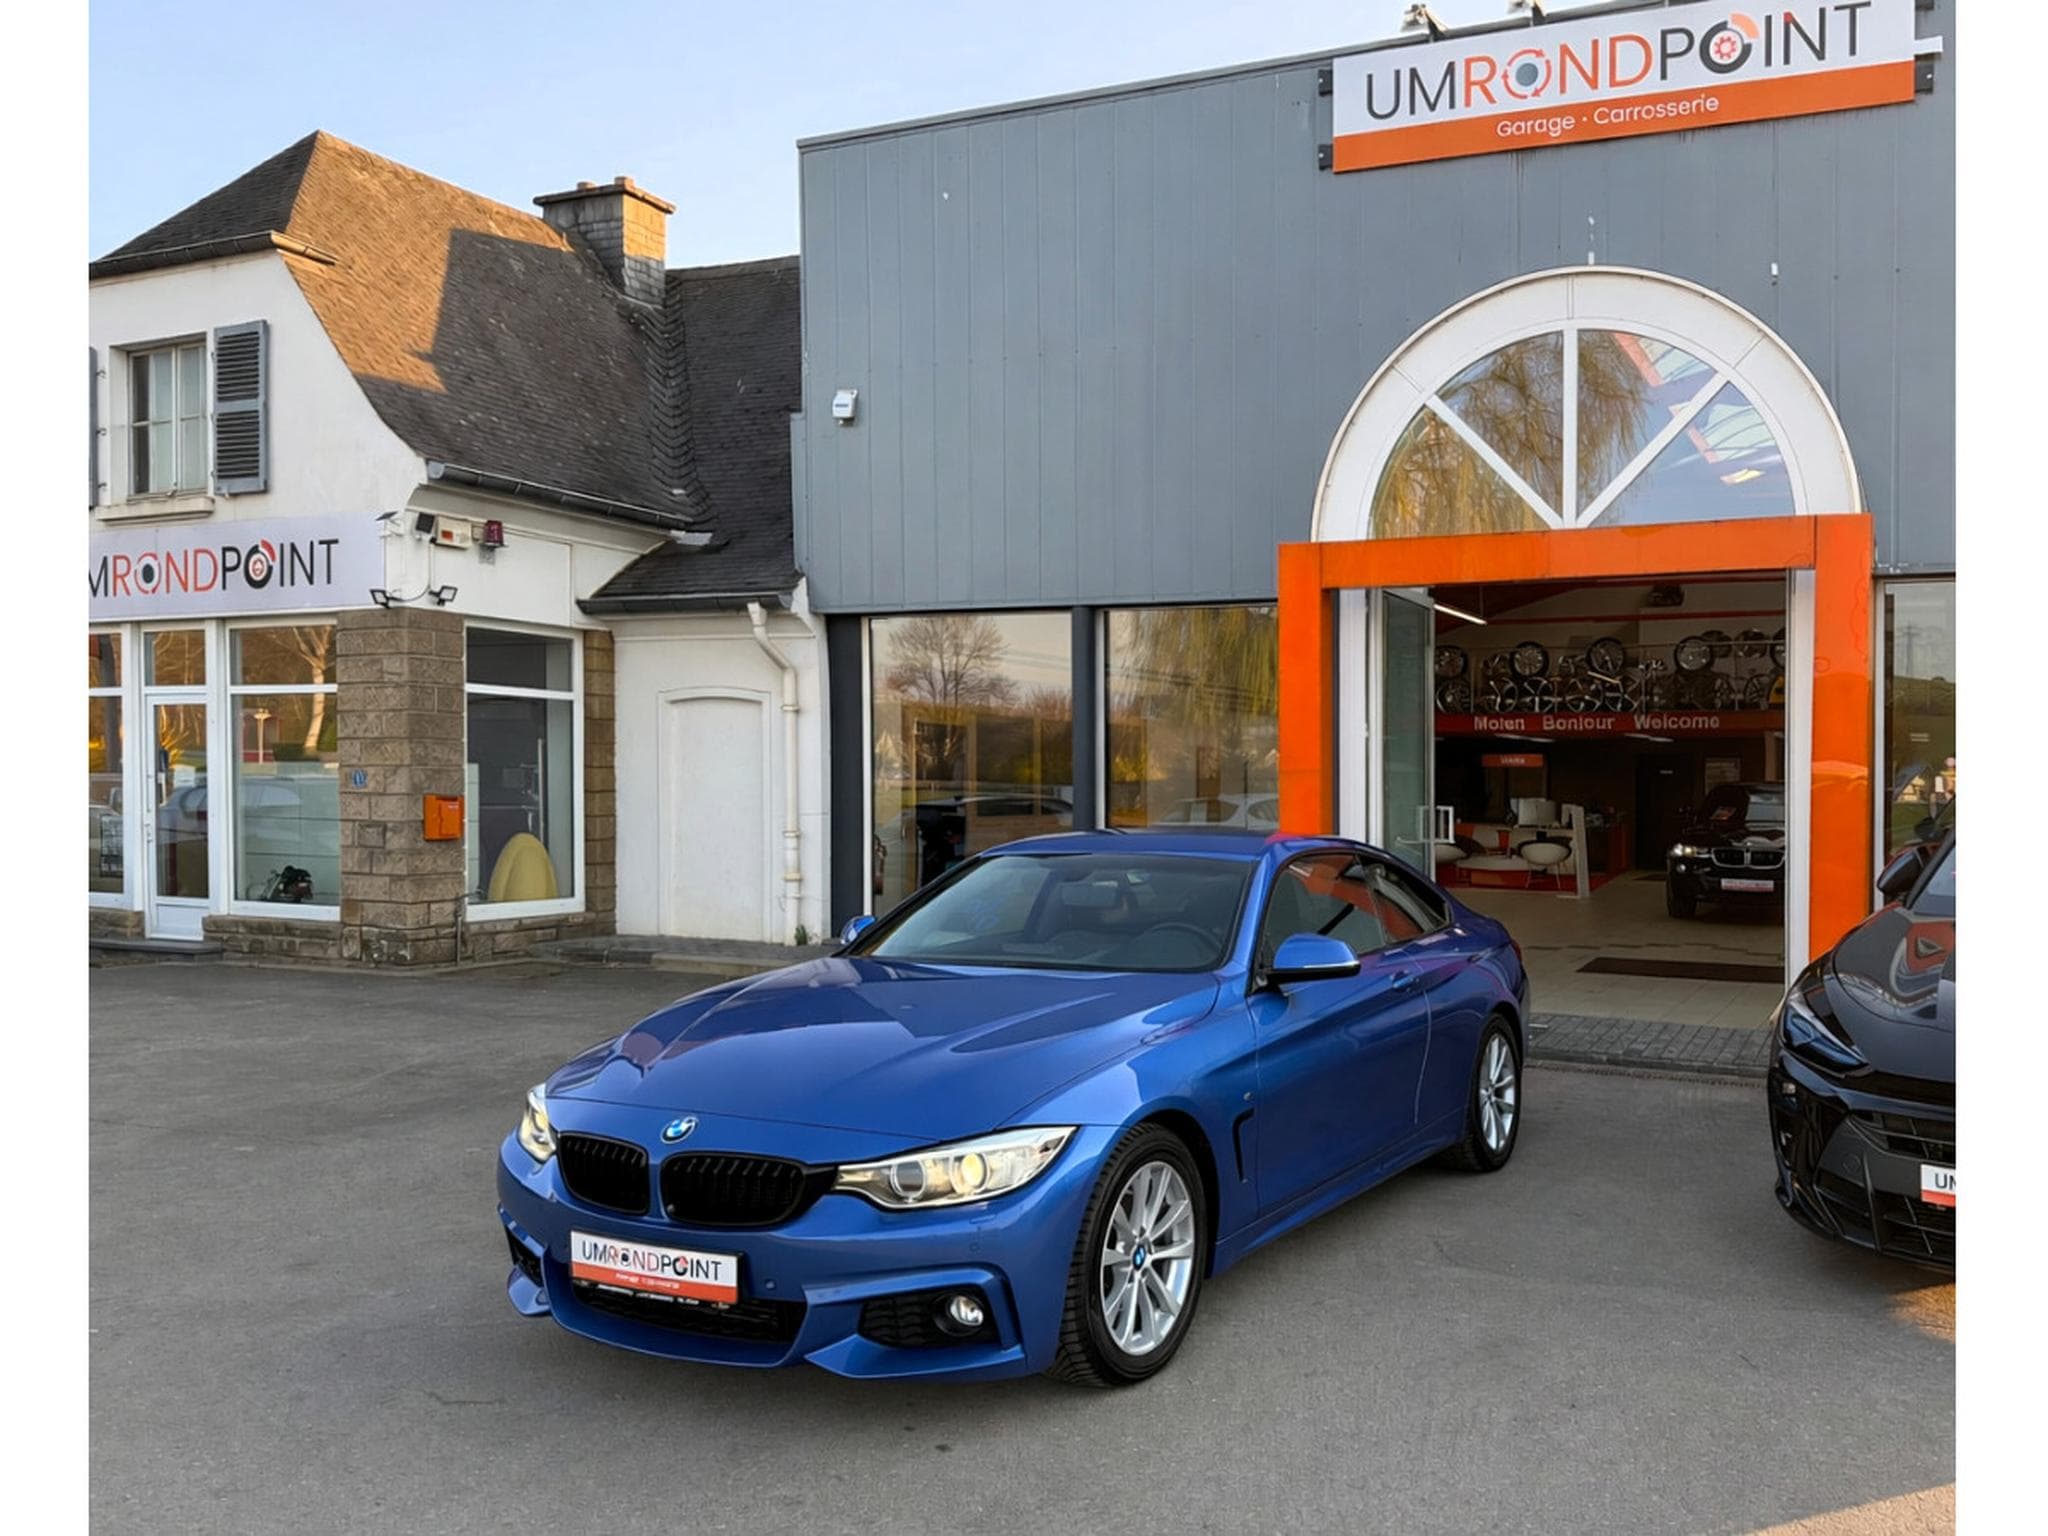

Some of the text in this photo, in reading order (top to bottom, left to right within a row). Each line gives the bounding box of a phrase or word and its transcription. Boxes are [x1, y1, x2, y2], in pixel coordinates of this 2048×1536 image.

[1366, 2, 1872, 120] UMRONDPOINT
[1497, 94, 1719, 138] Garage Carrosserie
[1634, 714, 1721, 731] Welcome
[582, 1240, 722, 1281] UMRONDPOINT
